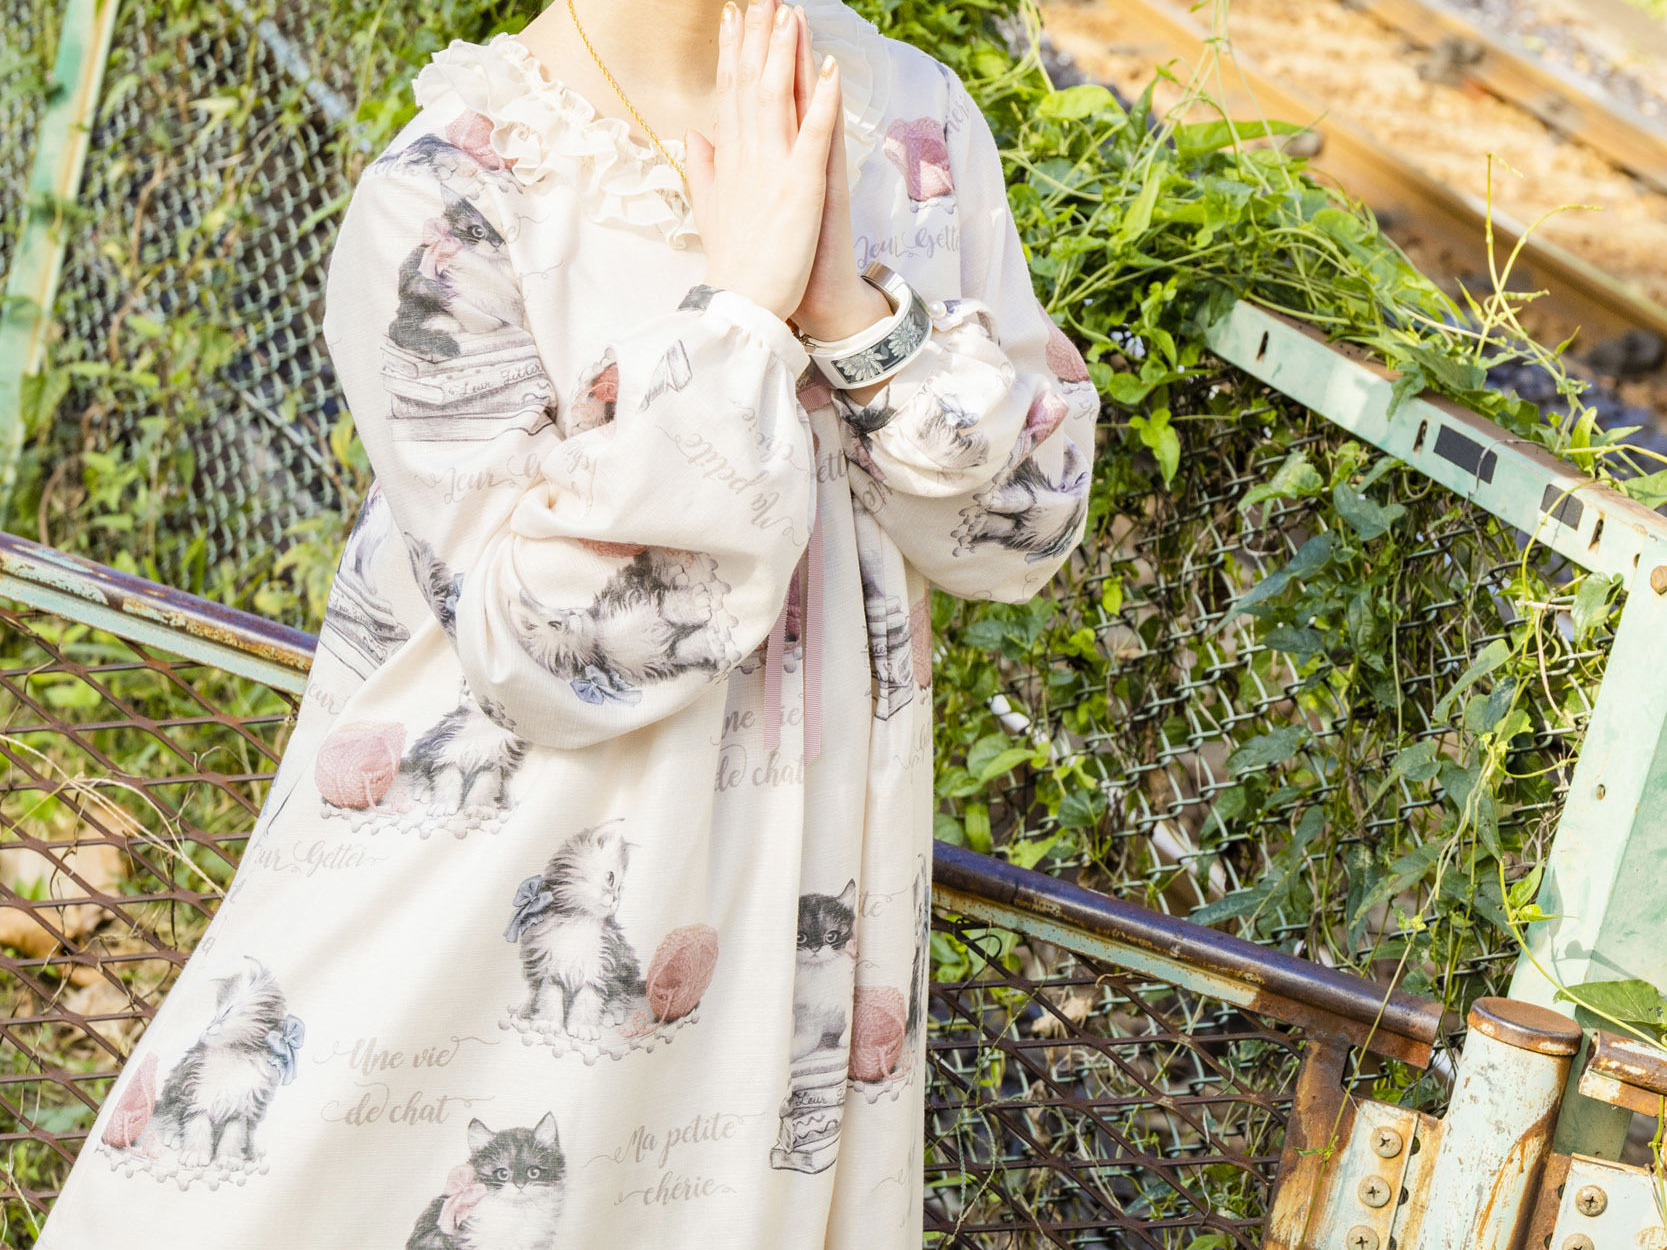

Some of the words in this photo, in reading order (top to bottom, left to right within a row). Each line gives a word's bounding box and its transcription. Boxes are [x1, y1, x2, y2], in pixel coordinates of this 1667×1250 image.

[722, 708, 756, 738] ne
[335, 1084, 390, 1126] de
[389, 1091, 470, 1125] chat
[658, 1112, 748, 1168] petite
[630, 1171, 724, 1206] chérie
